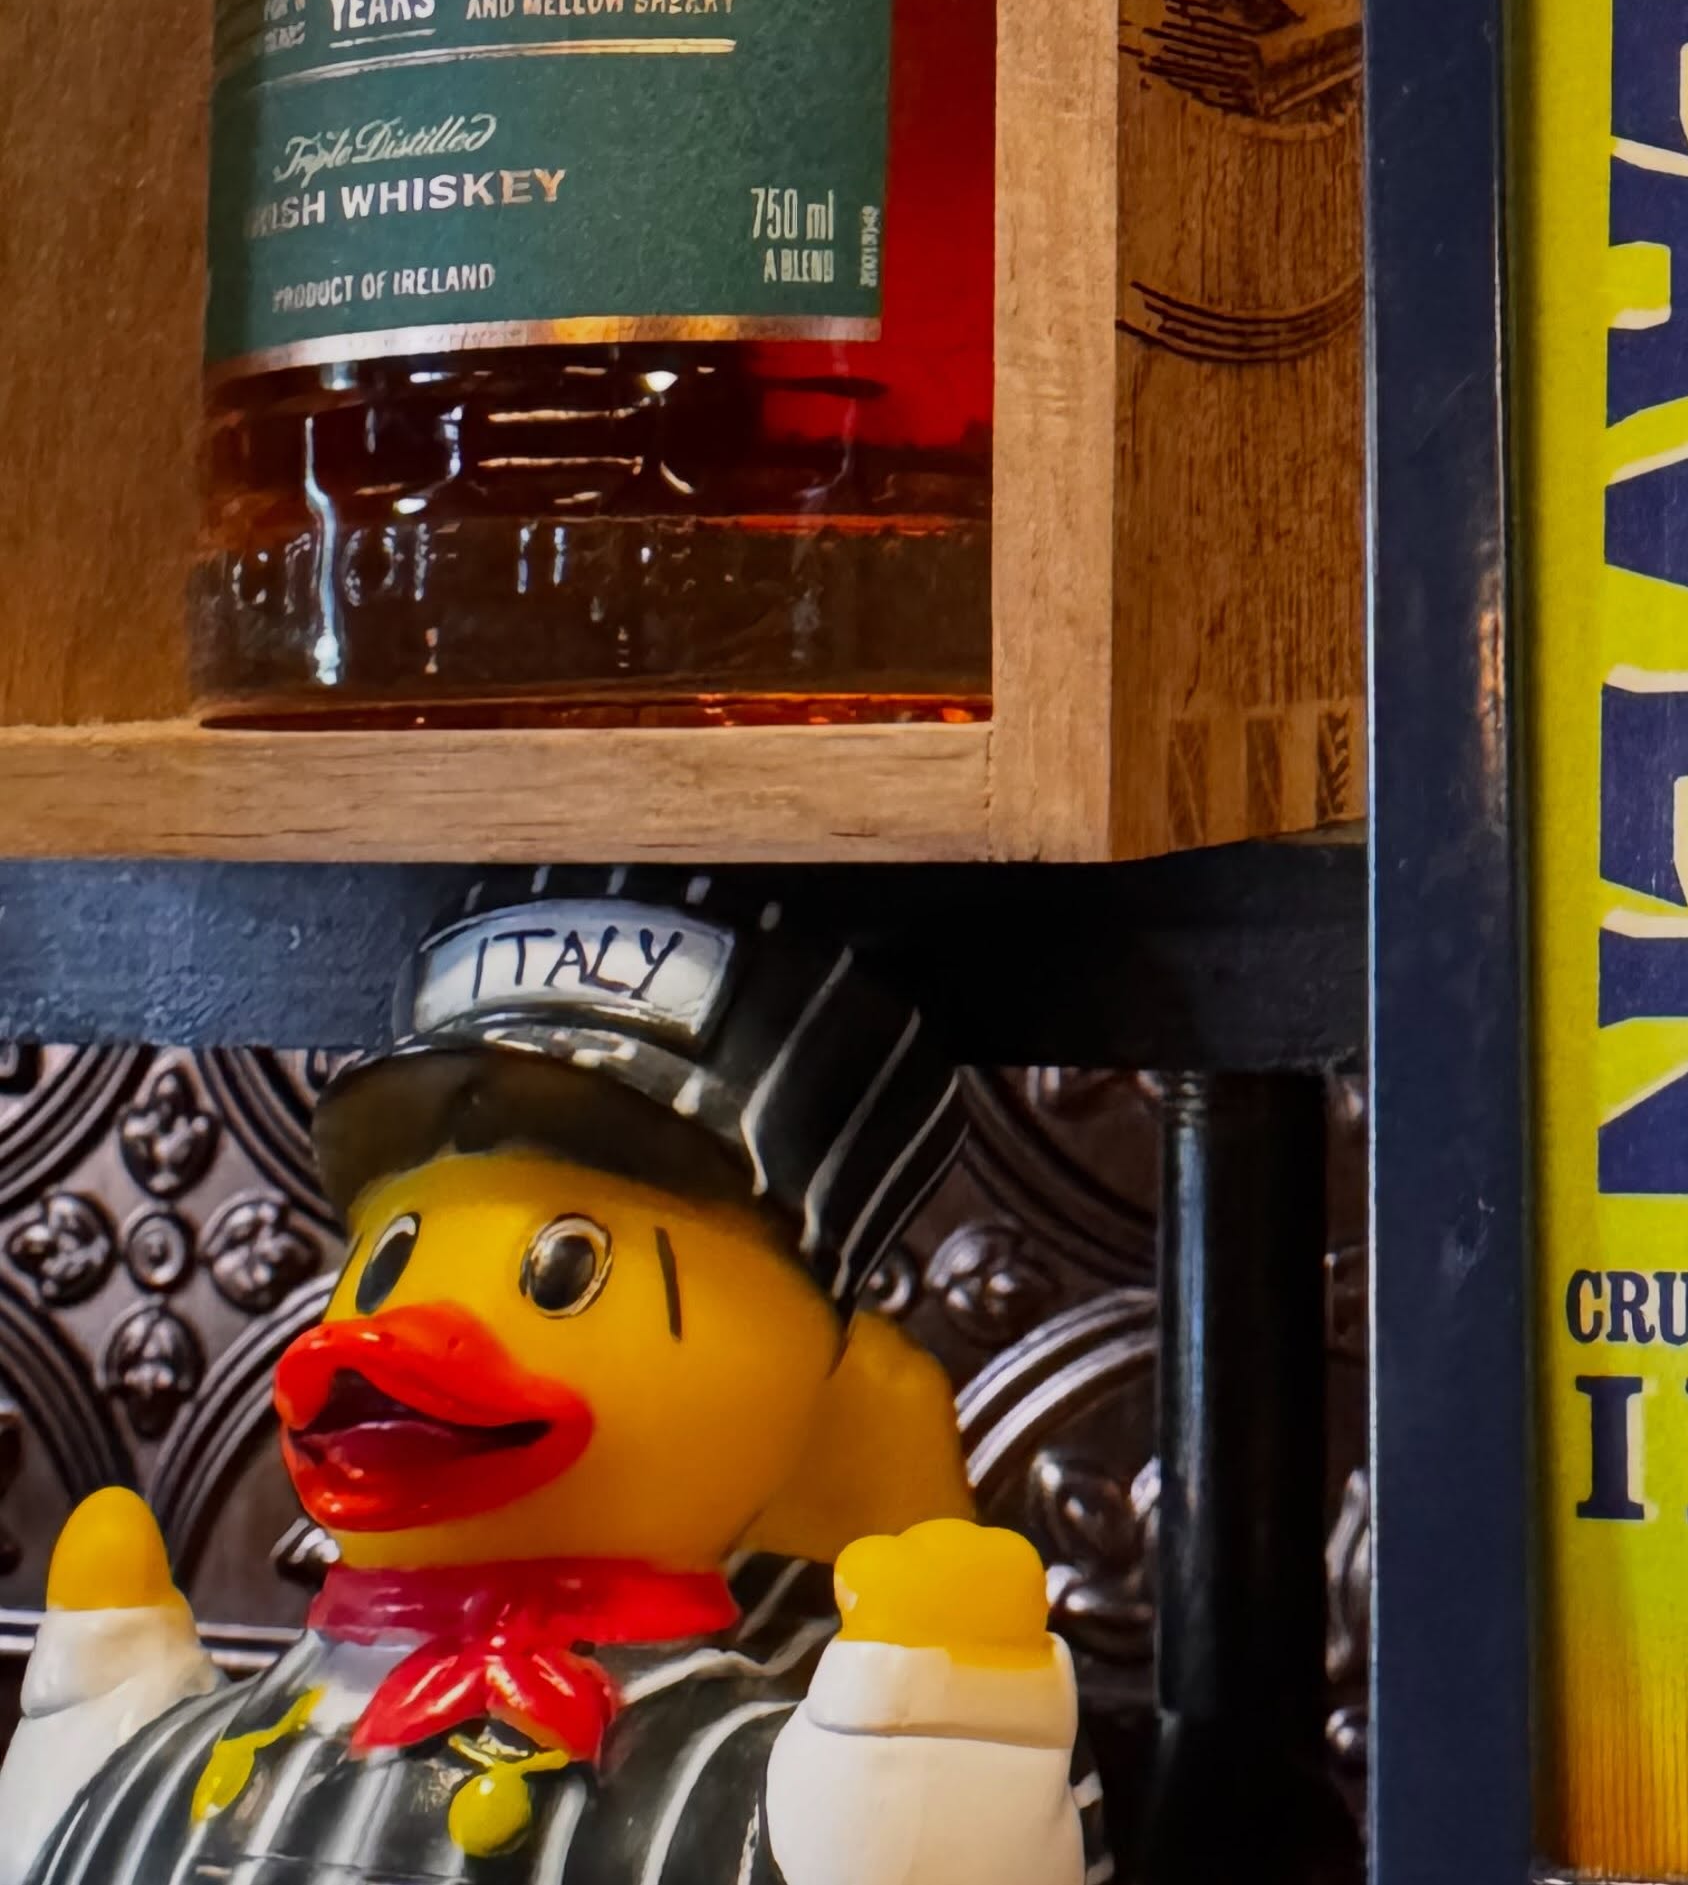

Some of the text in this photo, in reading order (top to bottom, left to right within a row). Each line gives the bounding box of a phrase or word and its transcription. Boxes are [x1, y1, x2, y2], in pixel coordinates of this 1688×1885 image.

[340, 168, 567, 220] WHISKEY
[750, 186, 835, 242] 750 ml
[272, 262, 497, 314] PRODUCT OF IRELAND
[471, 924, 684, 1002] ITALY
